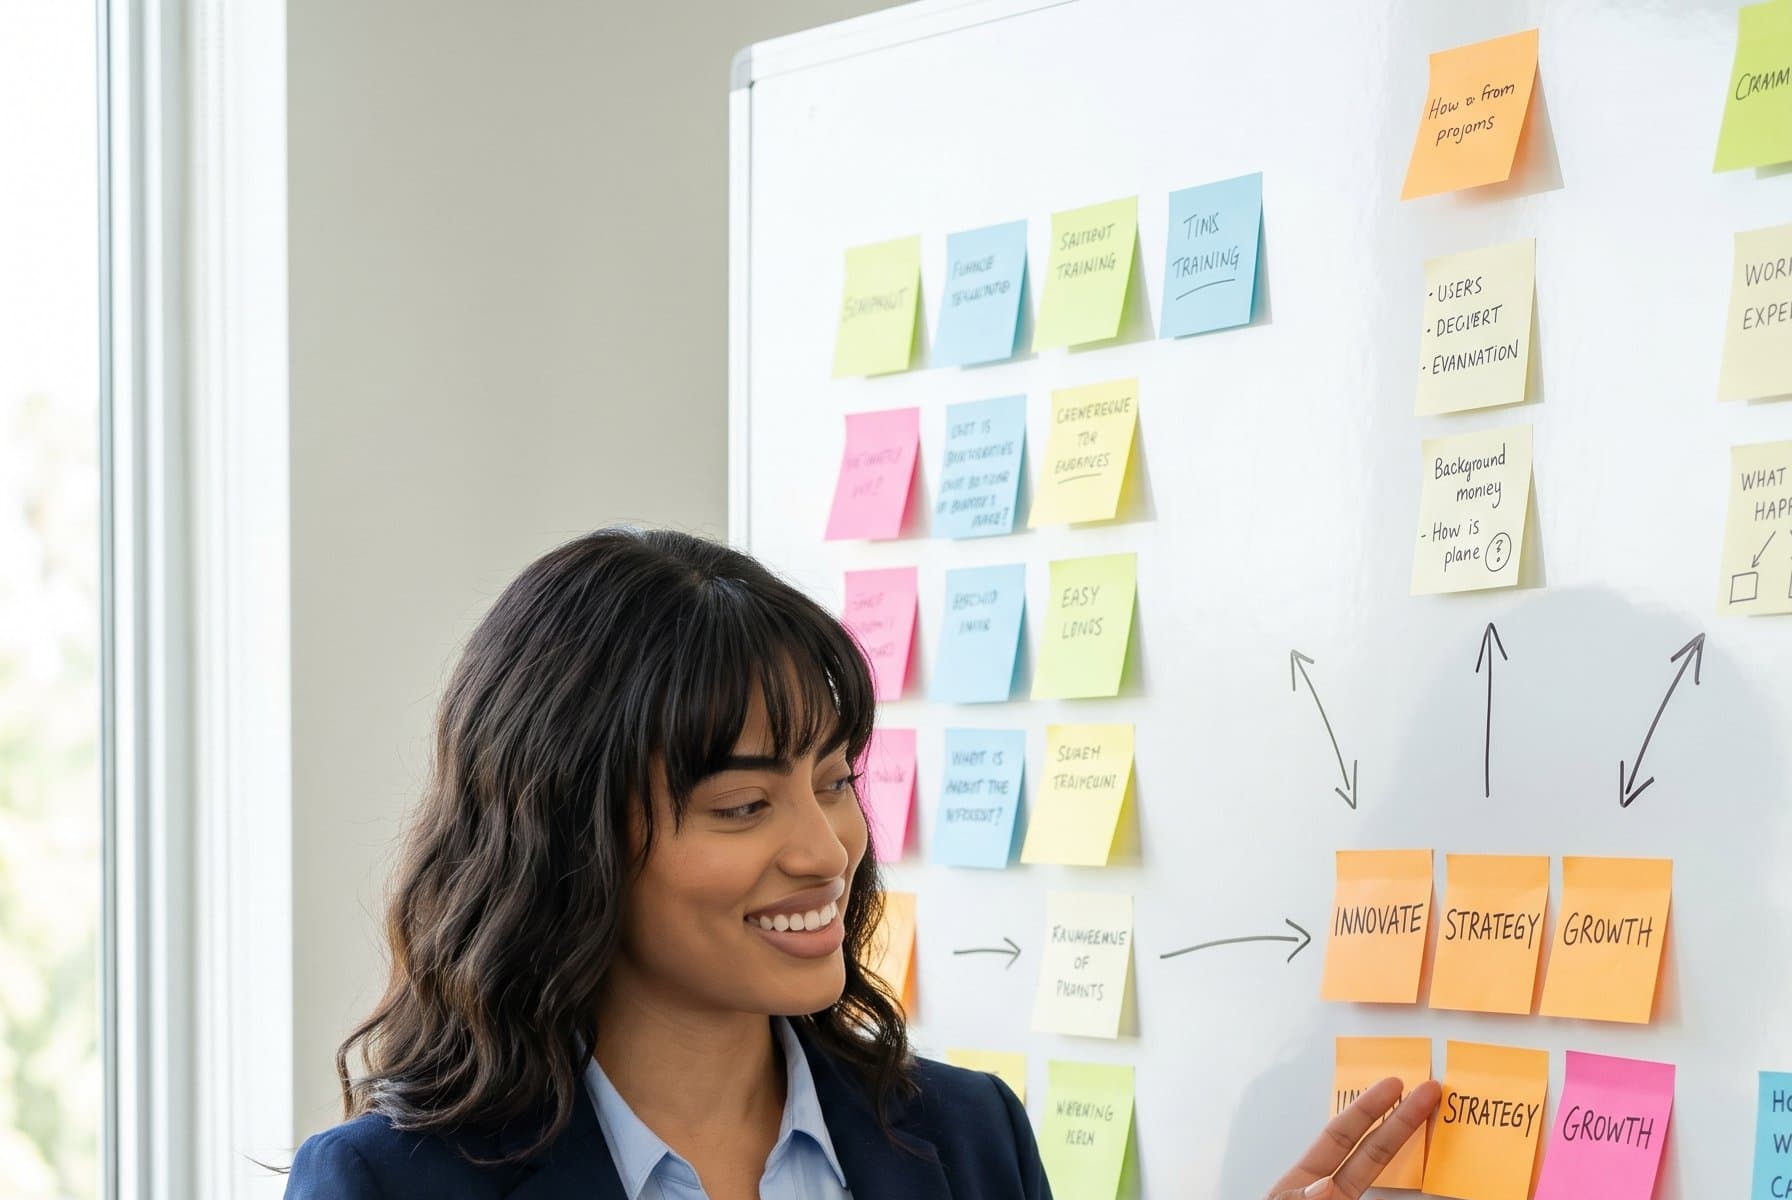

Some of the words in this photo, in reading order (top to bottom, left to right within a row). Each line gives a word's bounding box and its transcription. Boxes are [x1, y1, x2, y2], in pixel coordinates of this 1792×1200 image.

[1428, 97, 1460, 121] How
[1481, 83, 1516, 102] from
[1172, 244, 1241, 280] TRAINING
[1743, 300, 1792, 330] EXPE
[1434, 442, 1506, 482] Background
[1741, 466, 1787, 492] WHAT
[1432, 521, 1461, 543] How
[1468, 518, 1480, 536] is
[1444, 546, 1481, 573] plane
[1061, 584, 1101, 609] EASY
[1334, 902, 1425, 938] INNOVATE
[1444, 907, 1542, 951] STRATEGY
[1562, 910, 1654, 949] GROWTH
[1442, 1091, 1541, 1139] STRATEGY
[1562, 1105, 1655, 1151] GROWTH
